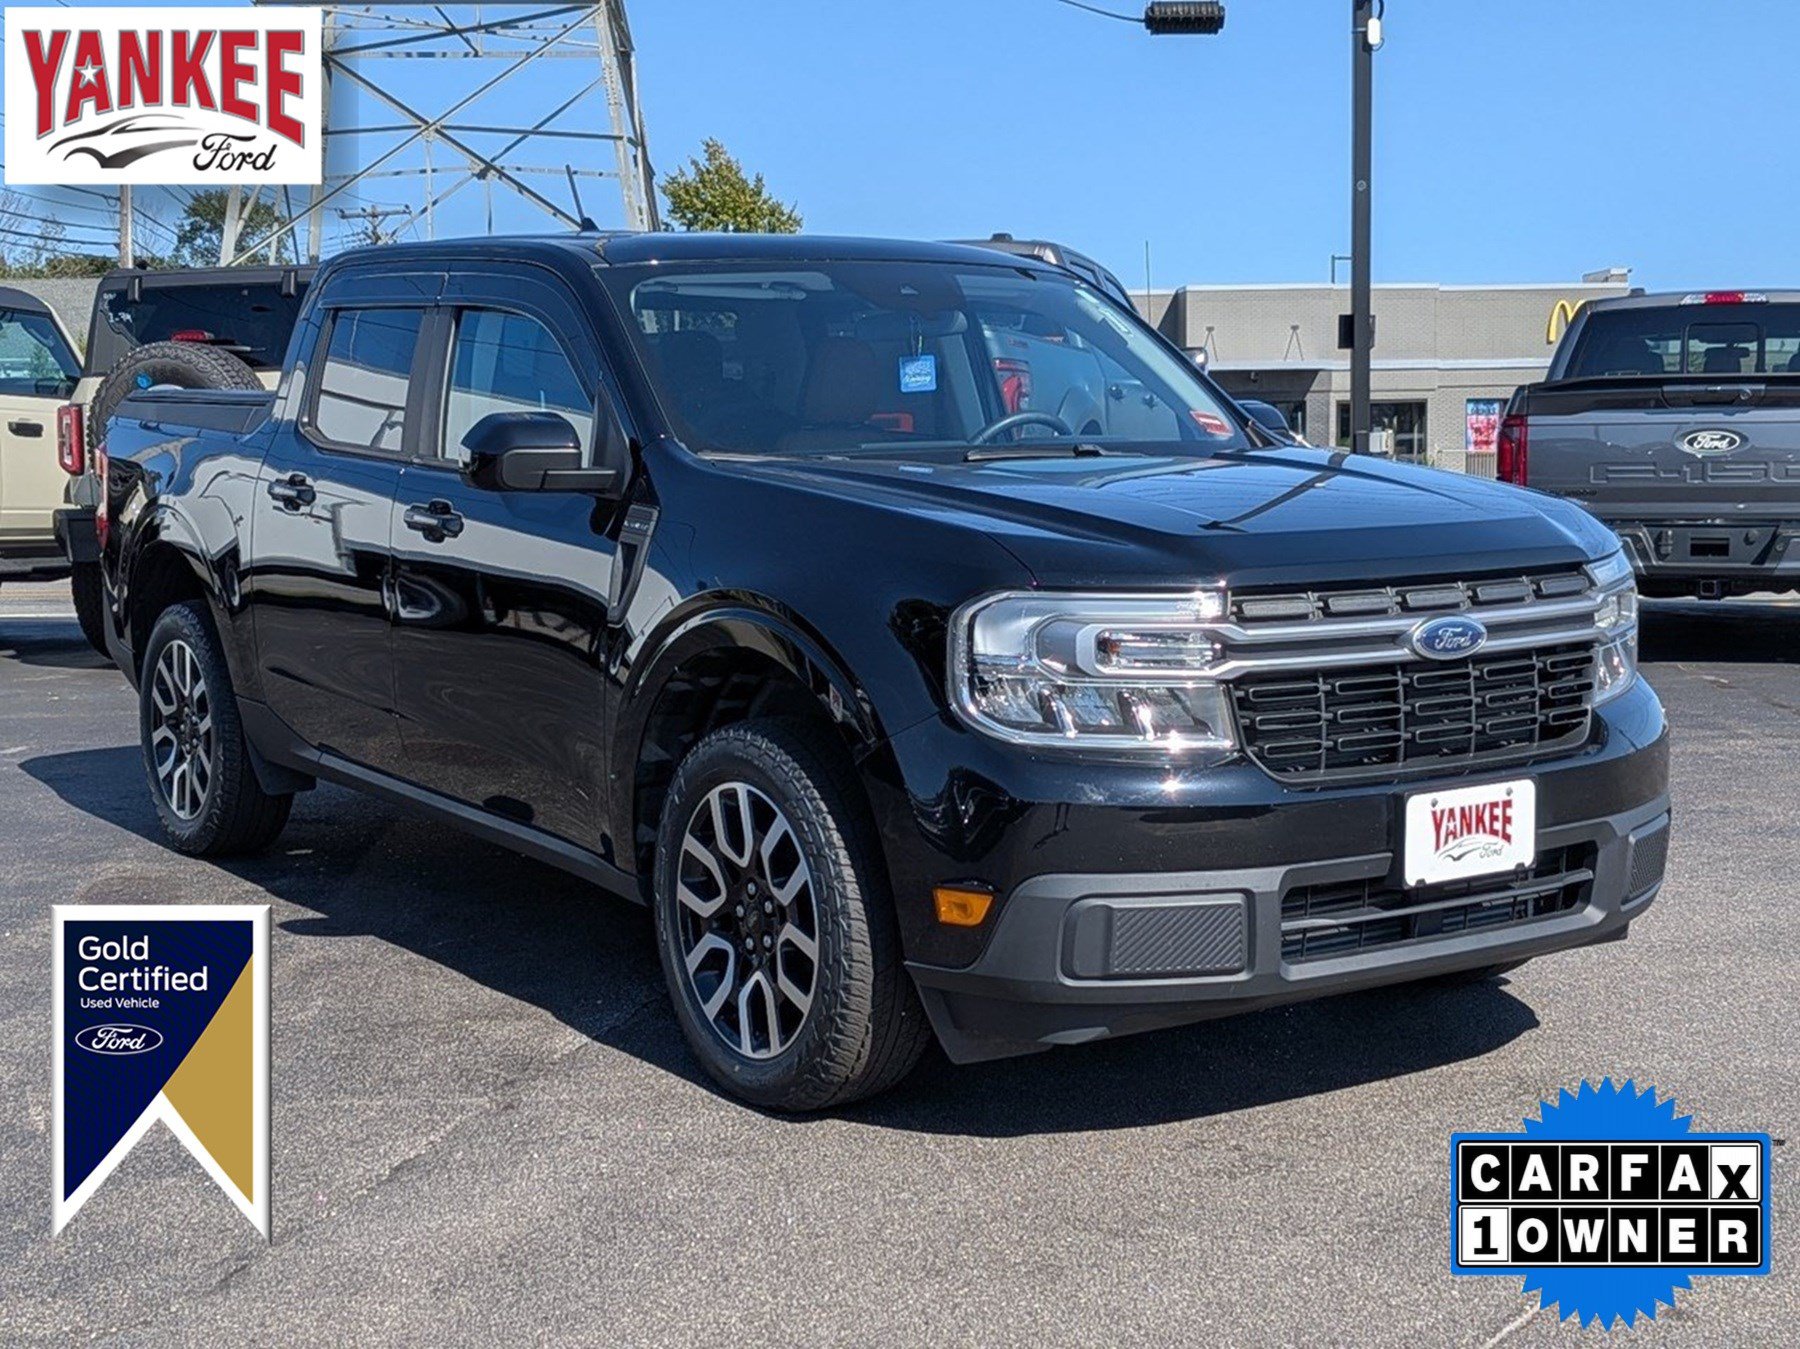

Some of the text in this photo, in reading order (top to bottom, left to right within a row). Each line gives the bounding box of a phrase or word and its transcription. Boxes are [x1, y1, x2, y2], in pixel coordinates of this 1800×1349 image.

[1693, 433, 1729, 450] Ford
[1434, 627, 1472, 650] Ford
[1431, 799, 1513, 853] YANKEE
[1479, 841, 1505, 859] Ford
